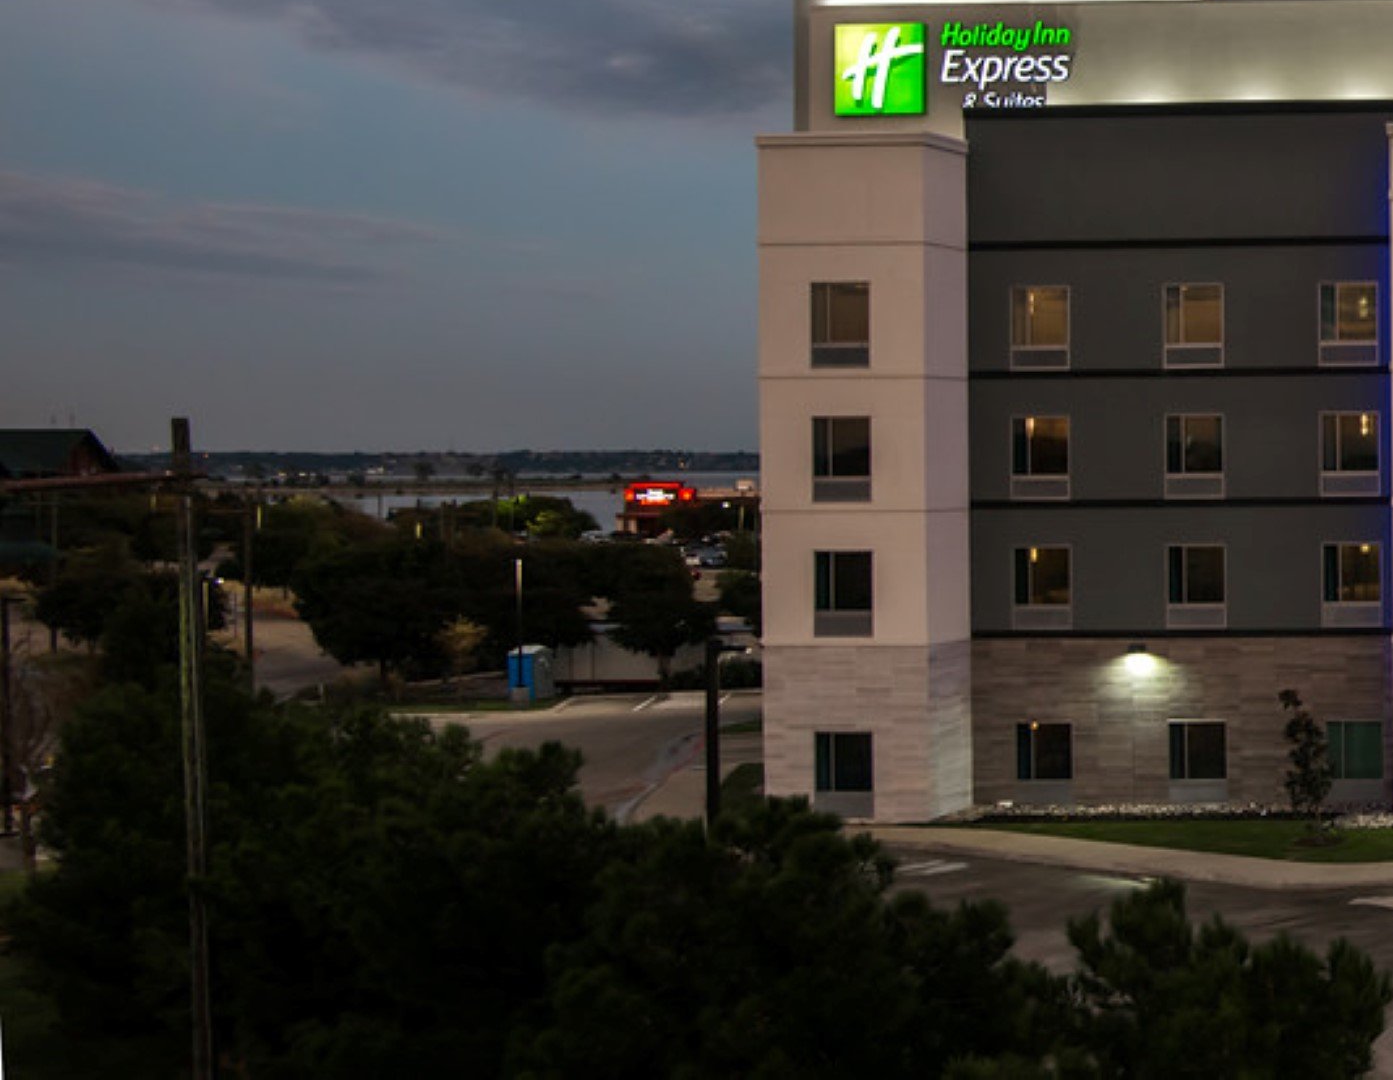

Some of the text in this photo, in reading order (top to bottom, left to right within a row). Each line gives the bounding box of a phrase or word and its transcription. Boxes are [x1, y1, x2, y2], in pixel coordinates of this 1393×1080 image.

[941, 21, 1071, 50] Holiday Inn
[842, 27, 923, 108] H
[941, 49, 1070, 90] Express
